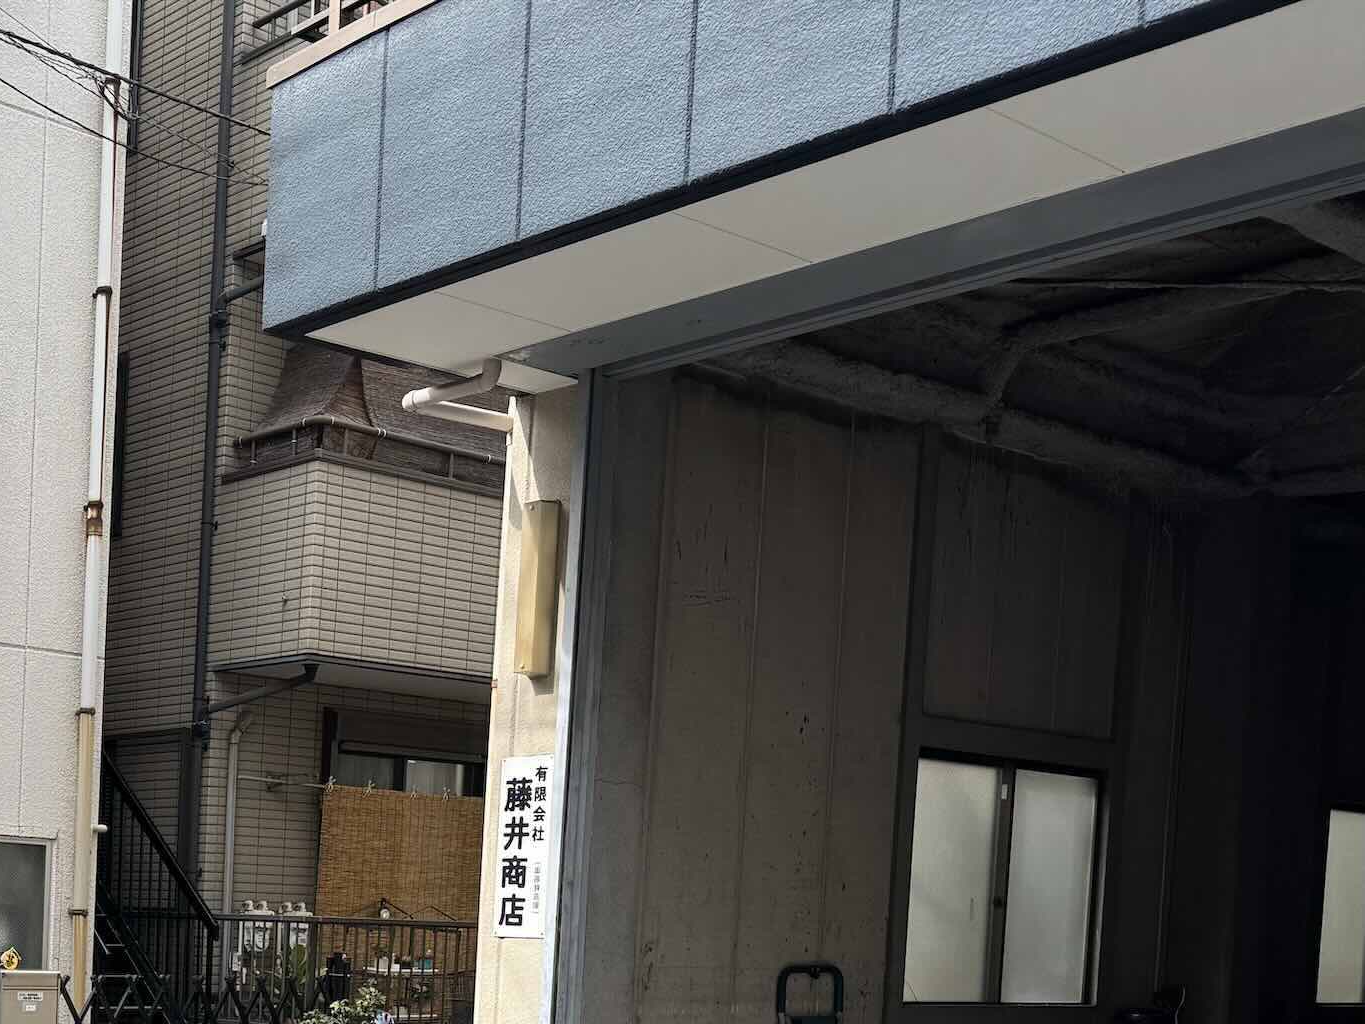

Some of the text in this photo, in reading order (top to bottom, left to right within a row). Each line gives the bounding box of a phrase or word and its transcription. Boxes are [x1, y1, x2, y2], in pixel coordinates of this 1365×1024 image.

[499, 777, 533, 927] 藤井商店
[532, 766, 548, 842] 有限会社
